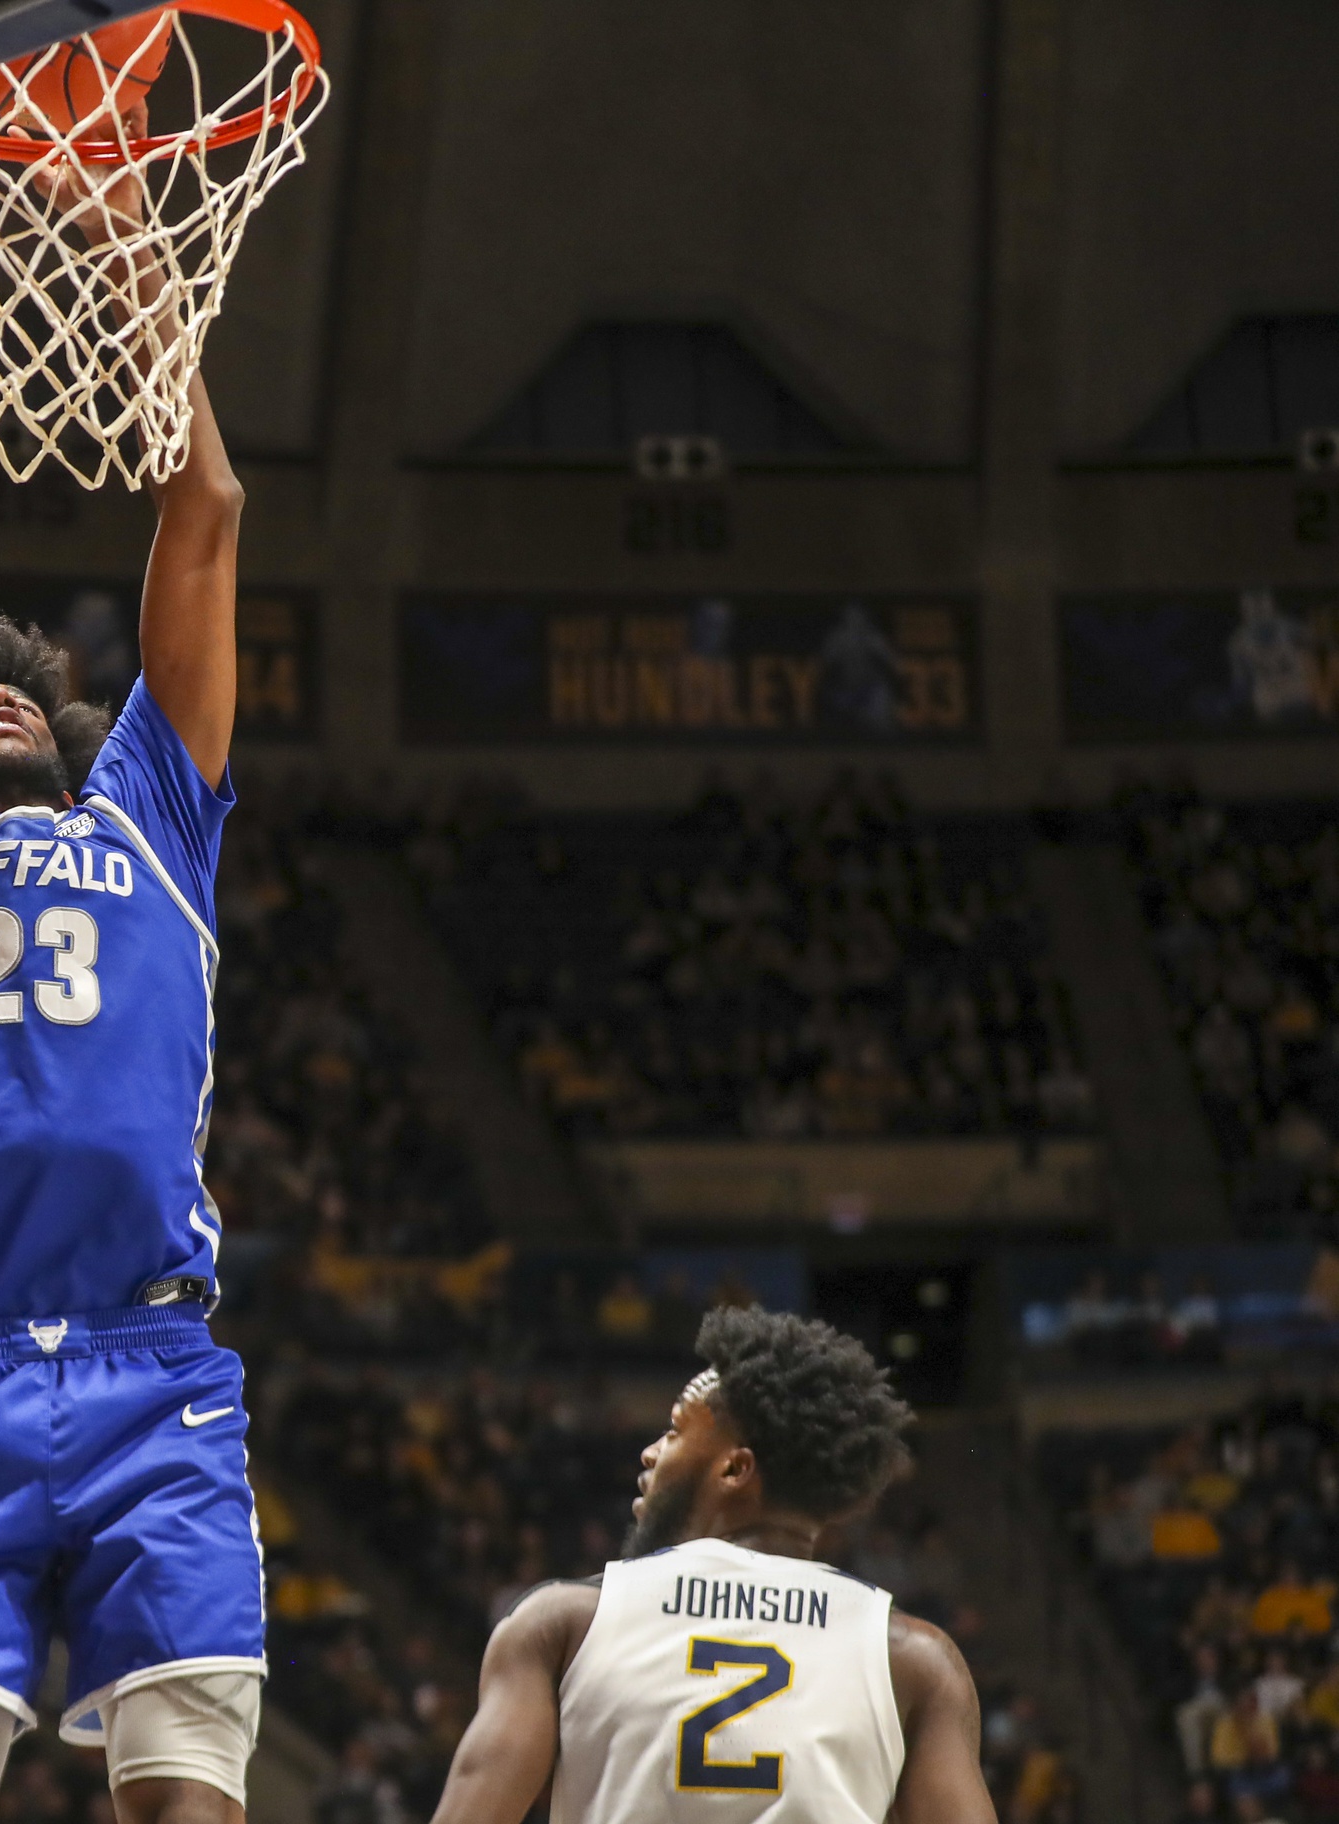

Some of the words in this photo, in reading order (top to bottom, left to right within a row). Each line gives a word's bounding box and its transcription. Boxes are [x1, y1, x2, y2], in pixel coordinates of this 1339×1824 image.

[548, 655, 822, 728] HUNDLEY
[895, 655, 968, 728] 33
[662, 1575, 828, 1628] JOHNSON
[675, 1636, 795, 1794] 2
